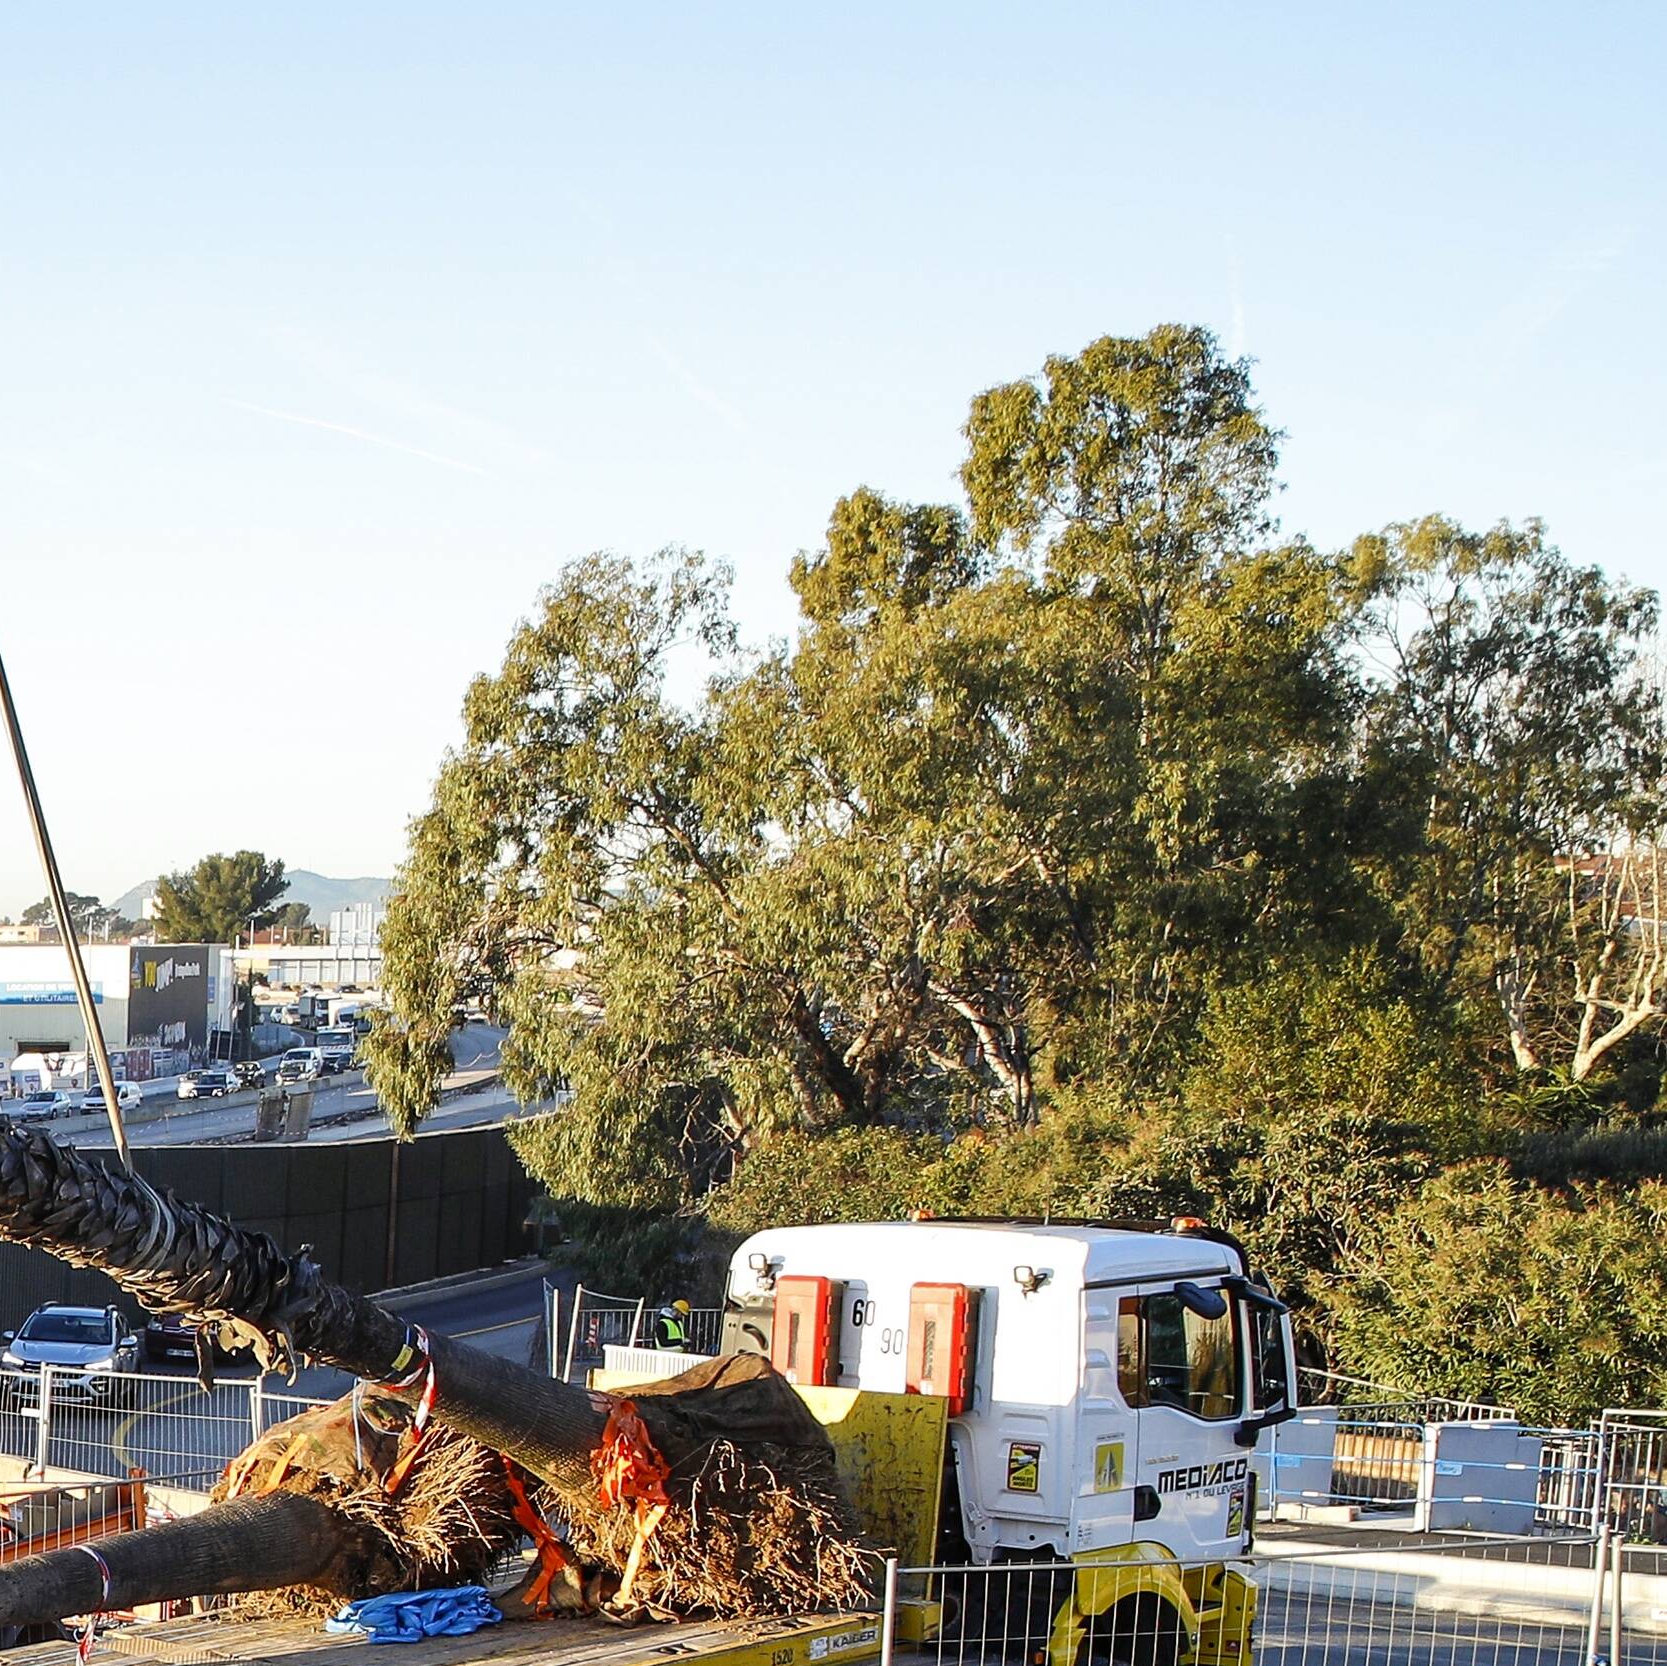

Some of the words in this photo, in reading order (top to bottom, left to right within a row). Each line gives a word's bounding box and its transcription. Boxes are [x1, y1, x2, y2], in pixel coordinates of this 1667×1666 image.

[6, 983, 44, 992] LOCATION
[23, 994, 33, 1002] ET
[852, 1299, 875, 1326] 60
[881, 1328, 903, 1354] 90
[771, 1649, 794, 1666] 1520
